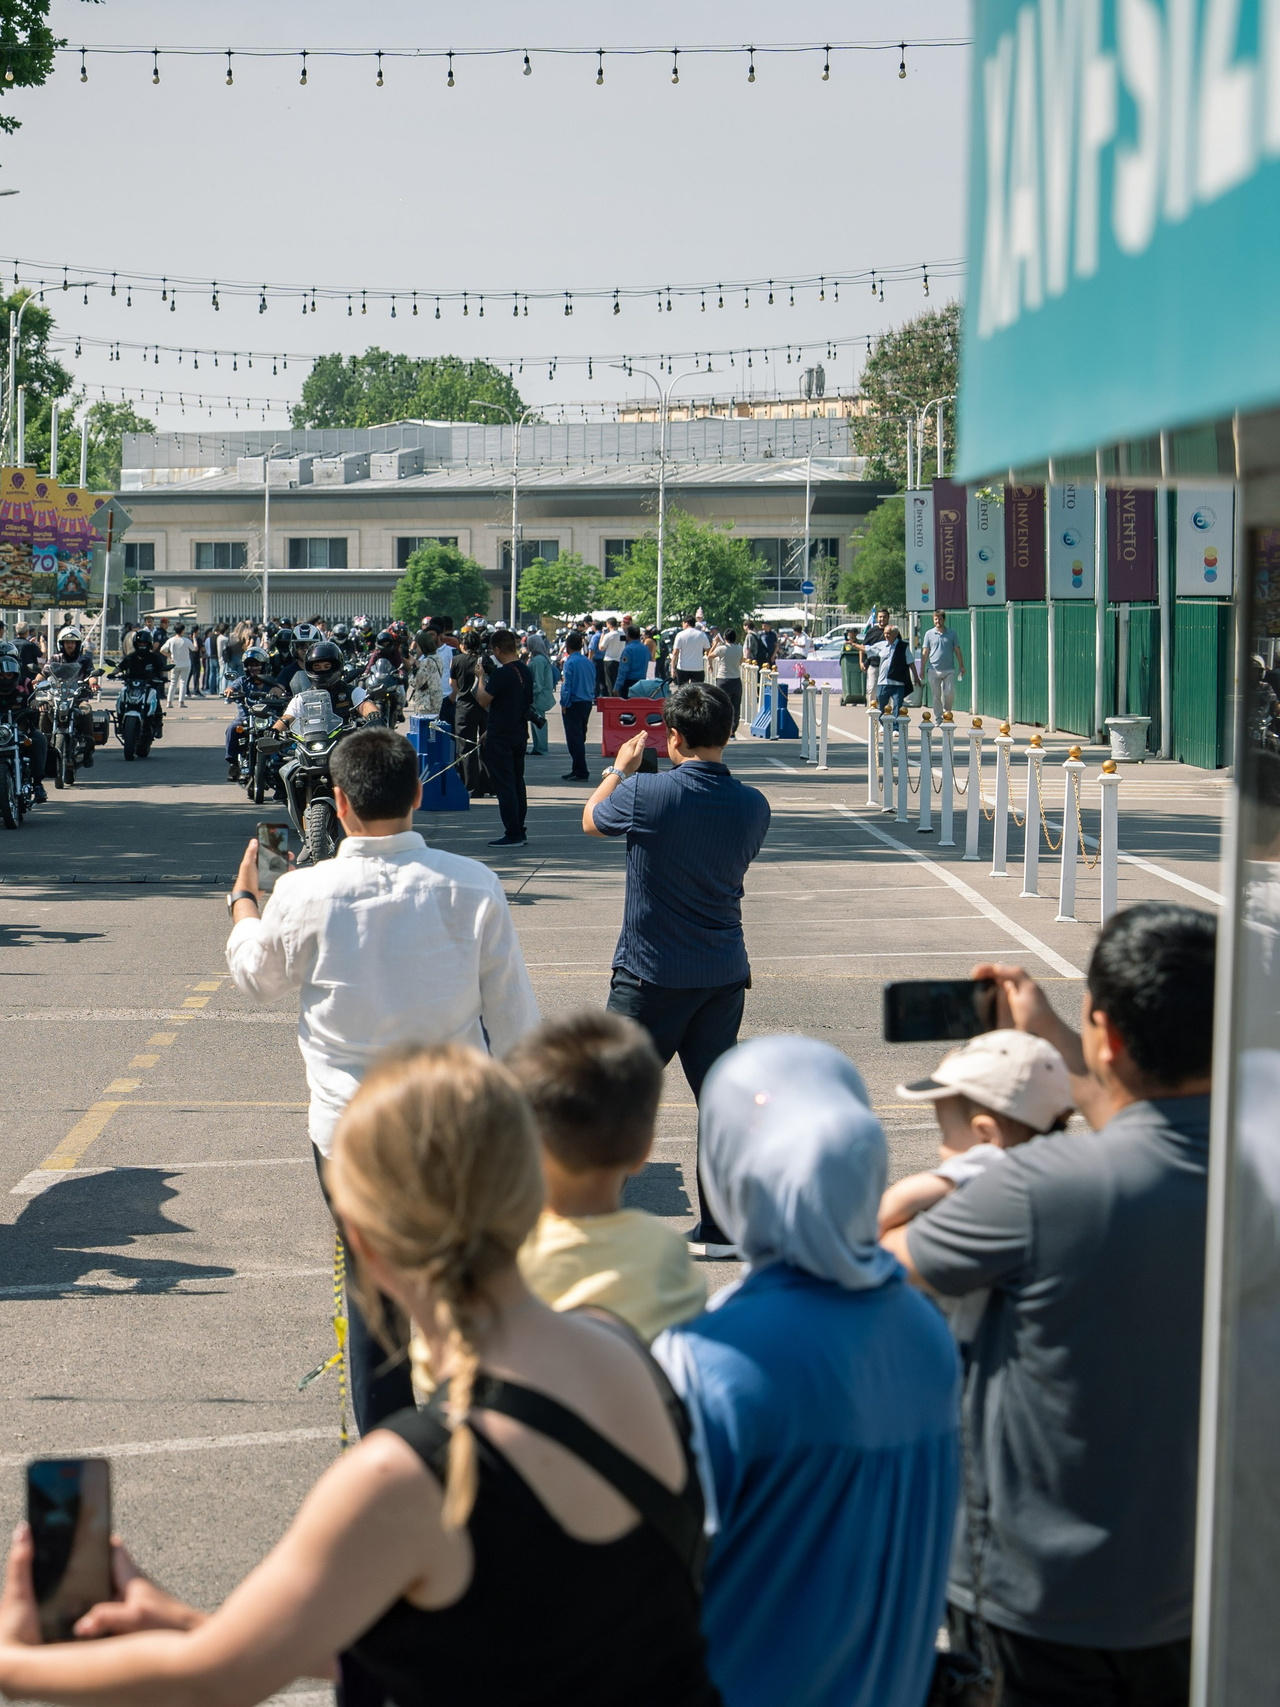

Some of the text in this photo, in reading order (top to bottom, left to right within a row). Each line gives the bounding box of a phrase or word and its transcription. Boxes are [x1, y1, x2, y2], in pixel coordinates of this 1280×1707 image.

[916, 509, 924, 547] INVENTO
[1017, 503, 1029, 568] INVENTO
[1123, 486, 1136, 561] NVENTO
[944, 526, 955, 582] INVENTO
